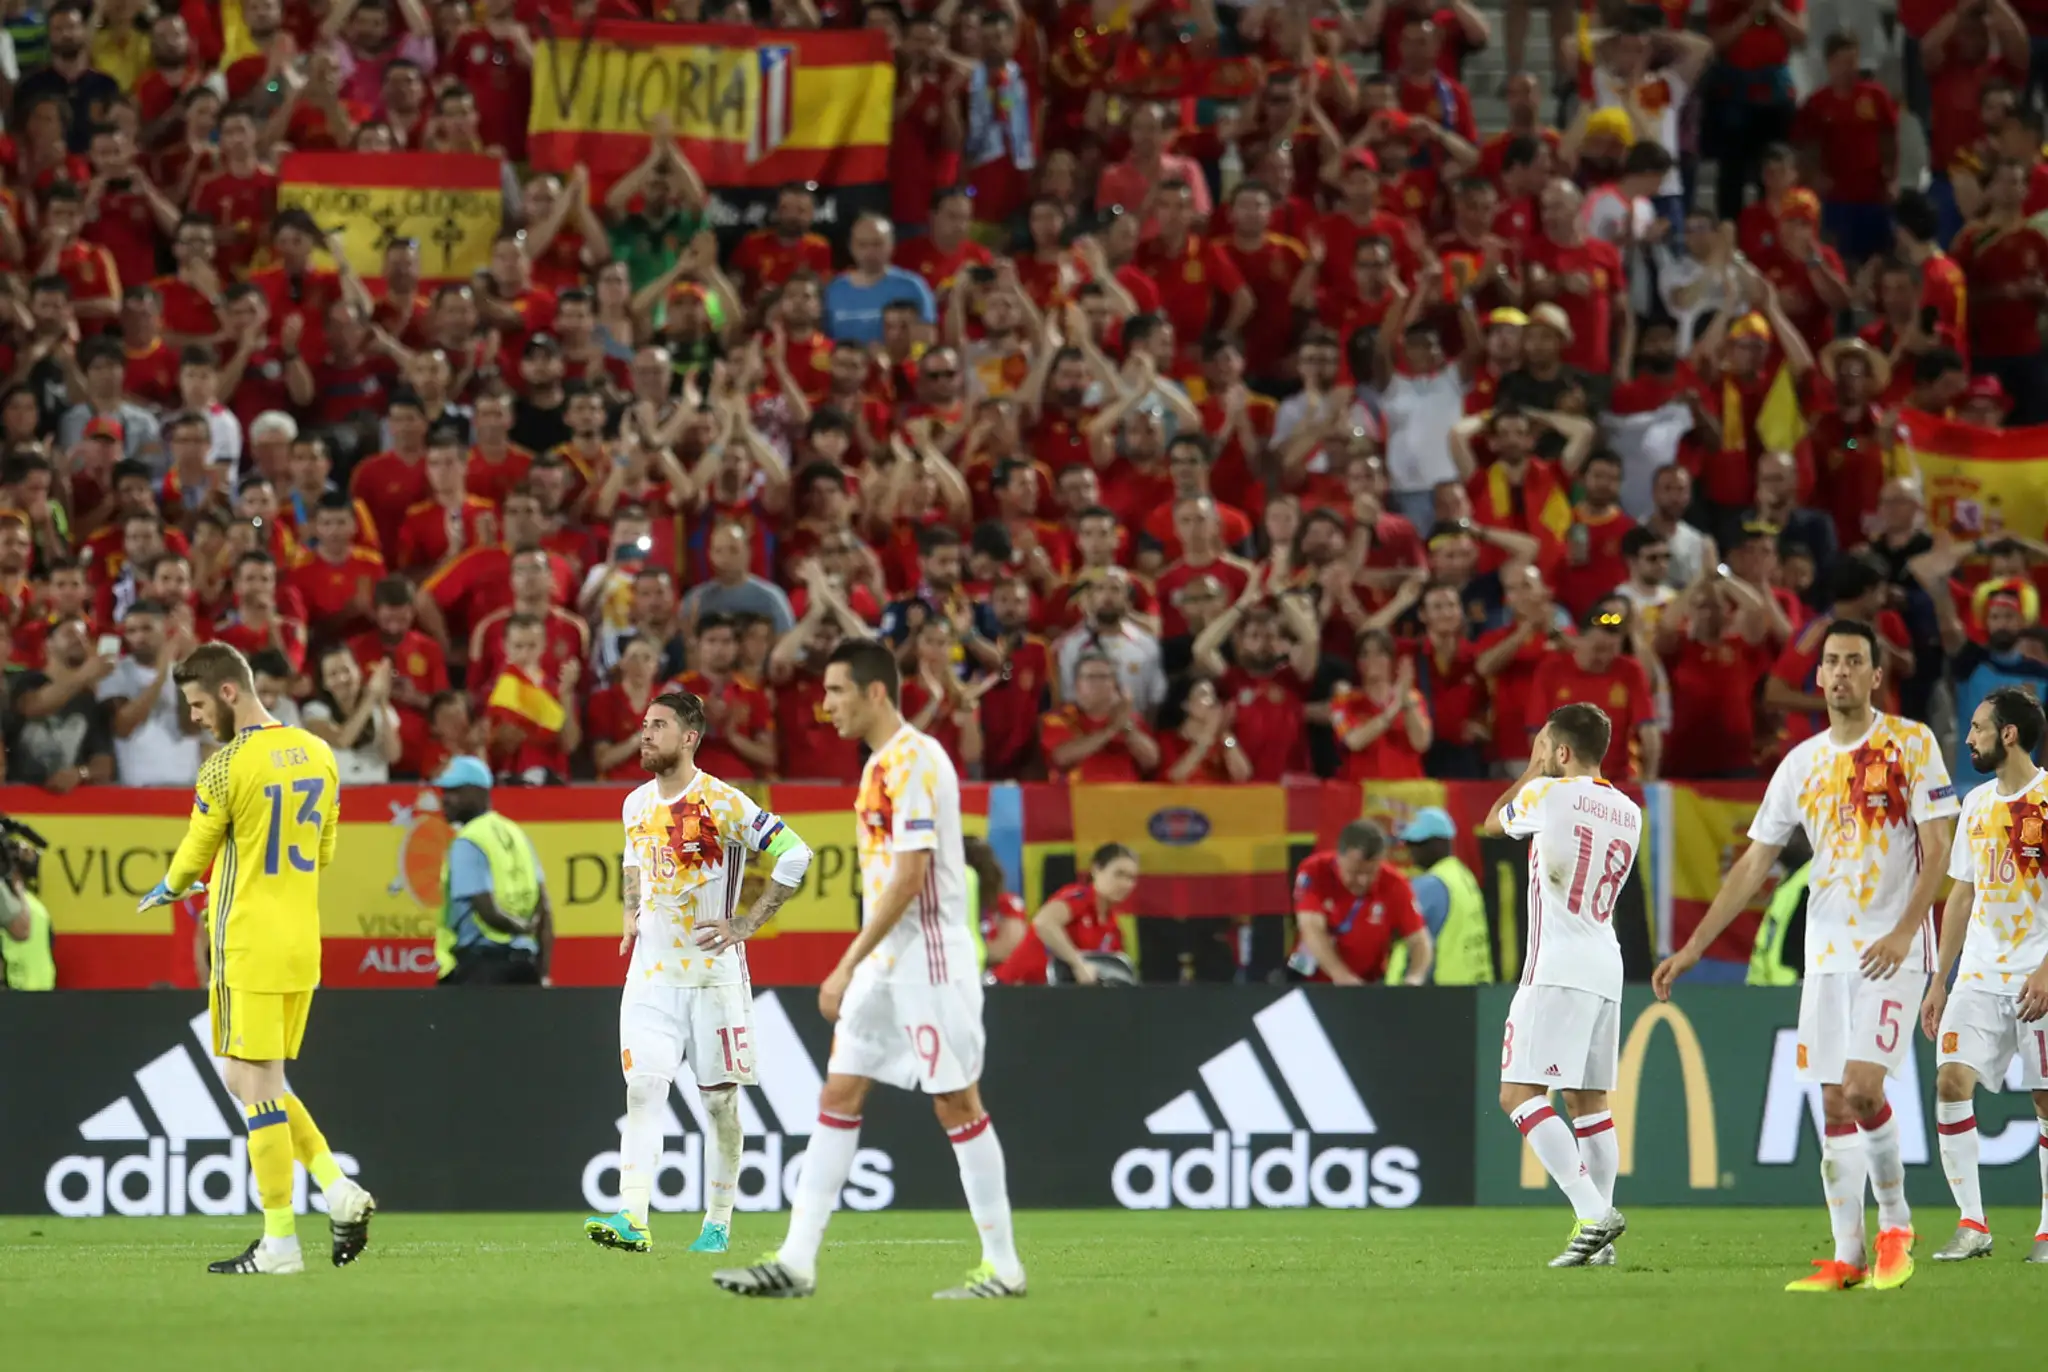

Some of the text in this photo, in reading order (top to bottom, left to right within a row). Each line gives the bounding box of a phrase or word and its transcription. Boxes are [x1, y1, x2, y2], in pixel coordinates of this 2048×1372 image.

[264, 778, 324, 875] 13
[1573, 795, 1637, 831] JORDI ALBA
[1838, 804, 1858, 842] 5
[650, 845, 676, 879] 15
[1567, 825, 1632, 923] 18
[1987, 847, 2016, 884] 16
[1876, 999, 1902, 1053] 5
[45, 1135, 361, 1217] adids
[582, 1133, 894, 1211] adds
[1111, 1130, 1421, 1209] adidas
